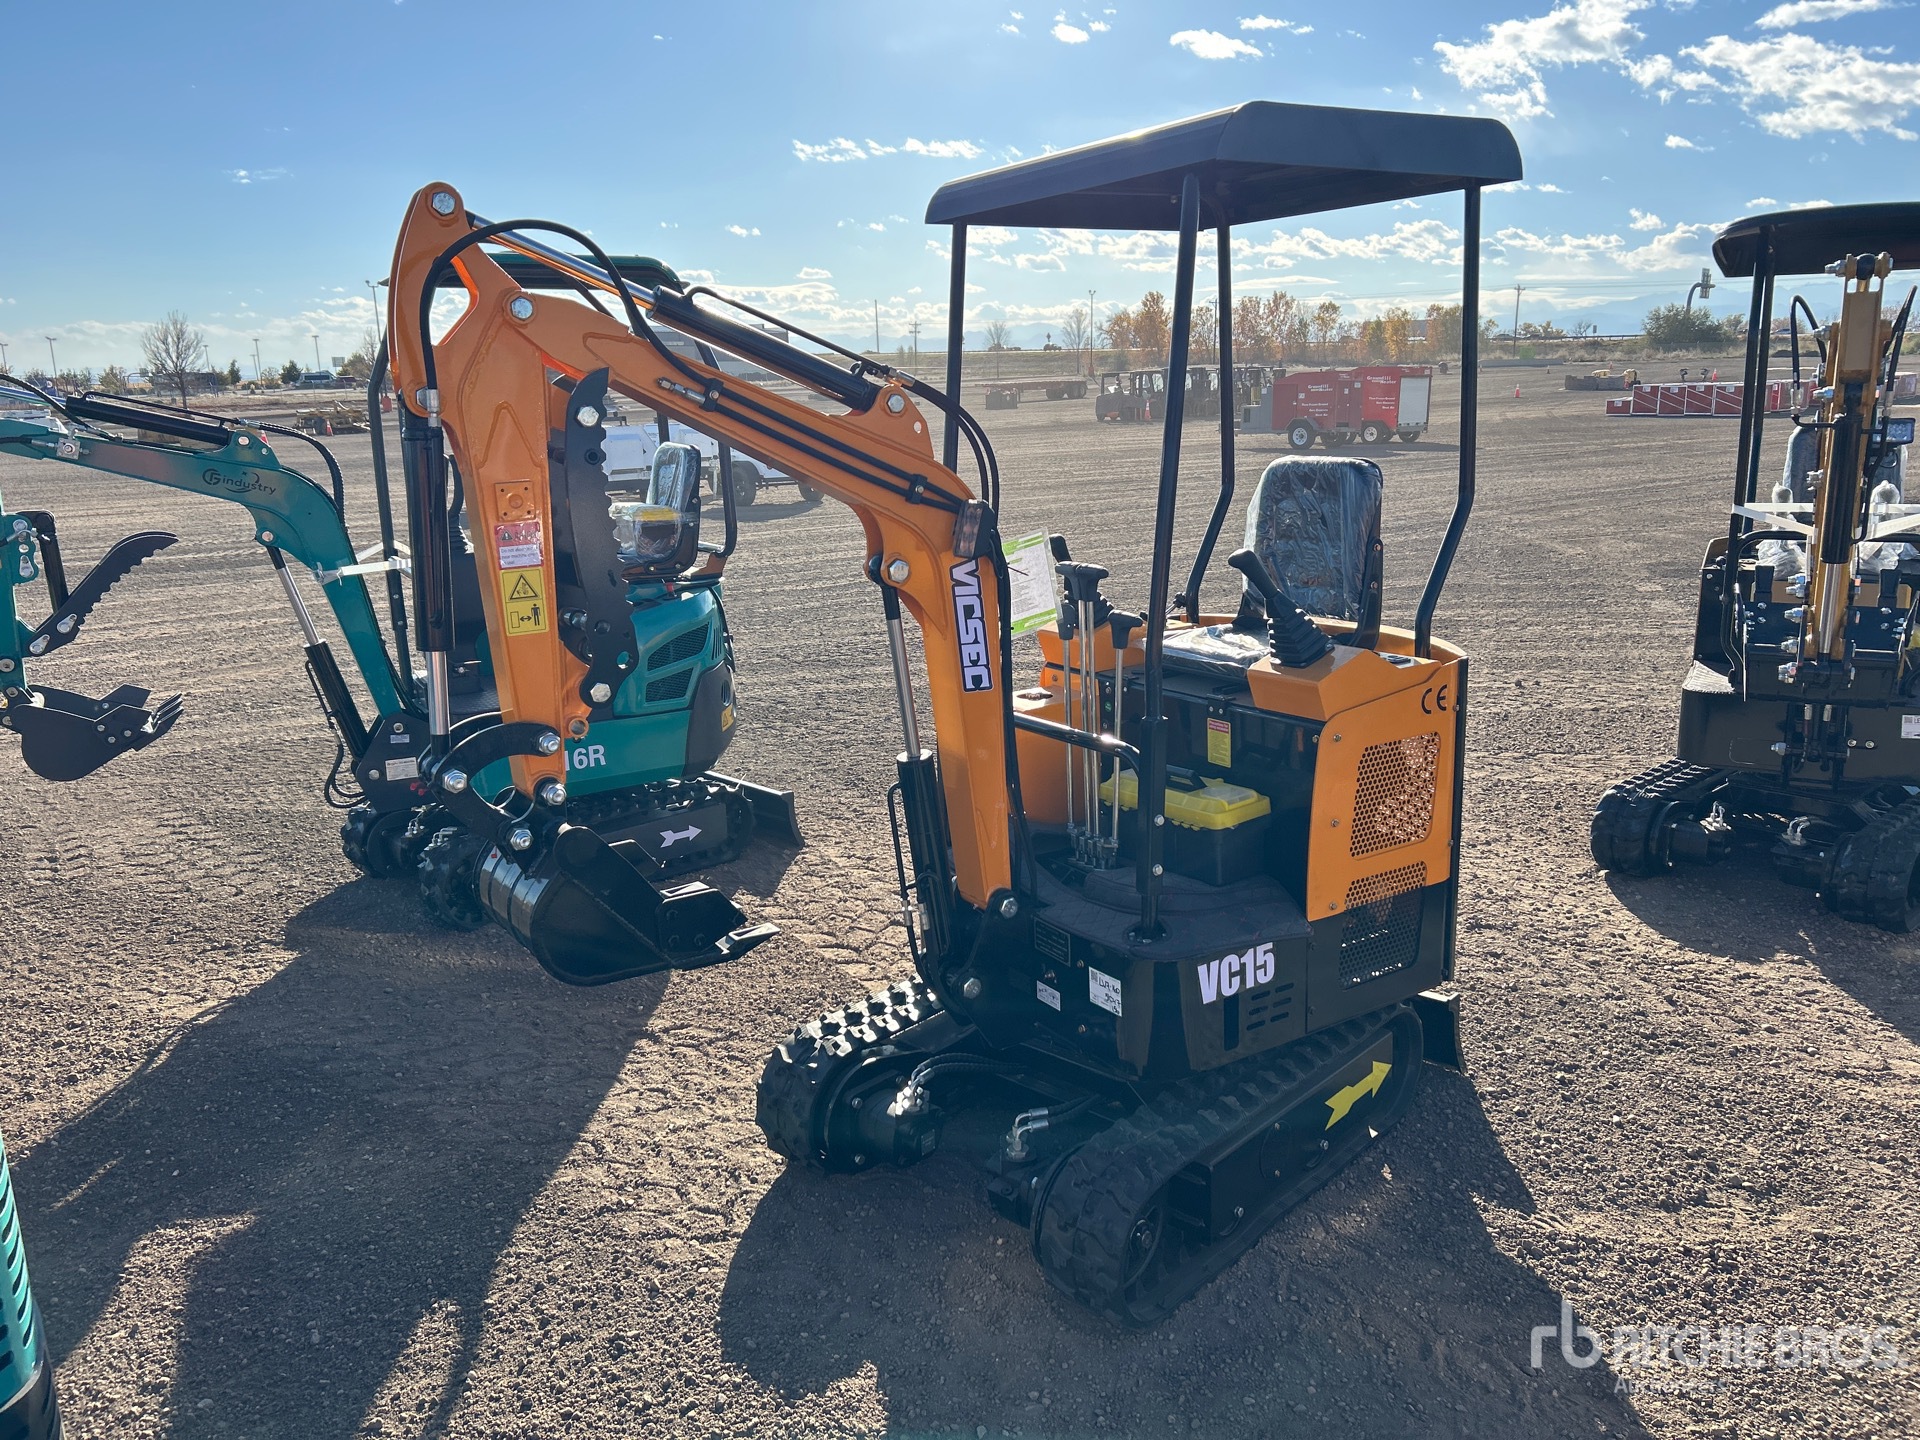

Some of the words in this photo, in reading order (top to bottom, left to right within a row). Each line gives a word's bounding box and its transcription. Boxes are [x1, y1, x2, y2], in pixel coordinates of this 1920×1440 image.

[951, 559, 991, 690] VICSEC
[1421, 684, 1448, 714] CE
[1197, 942, 1275, 1005] VC15
